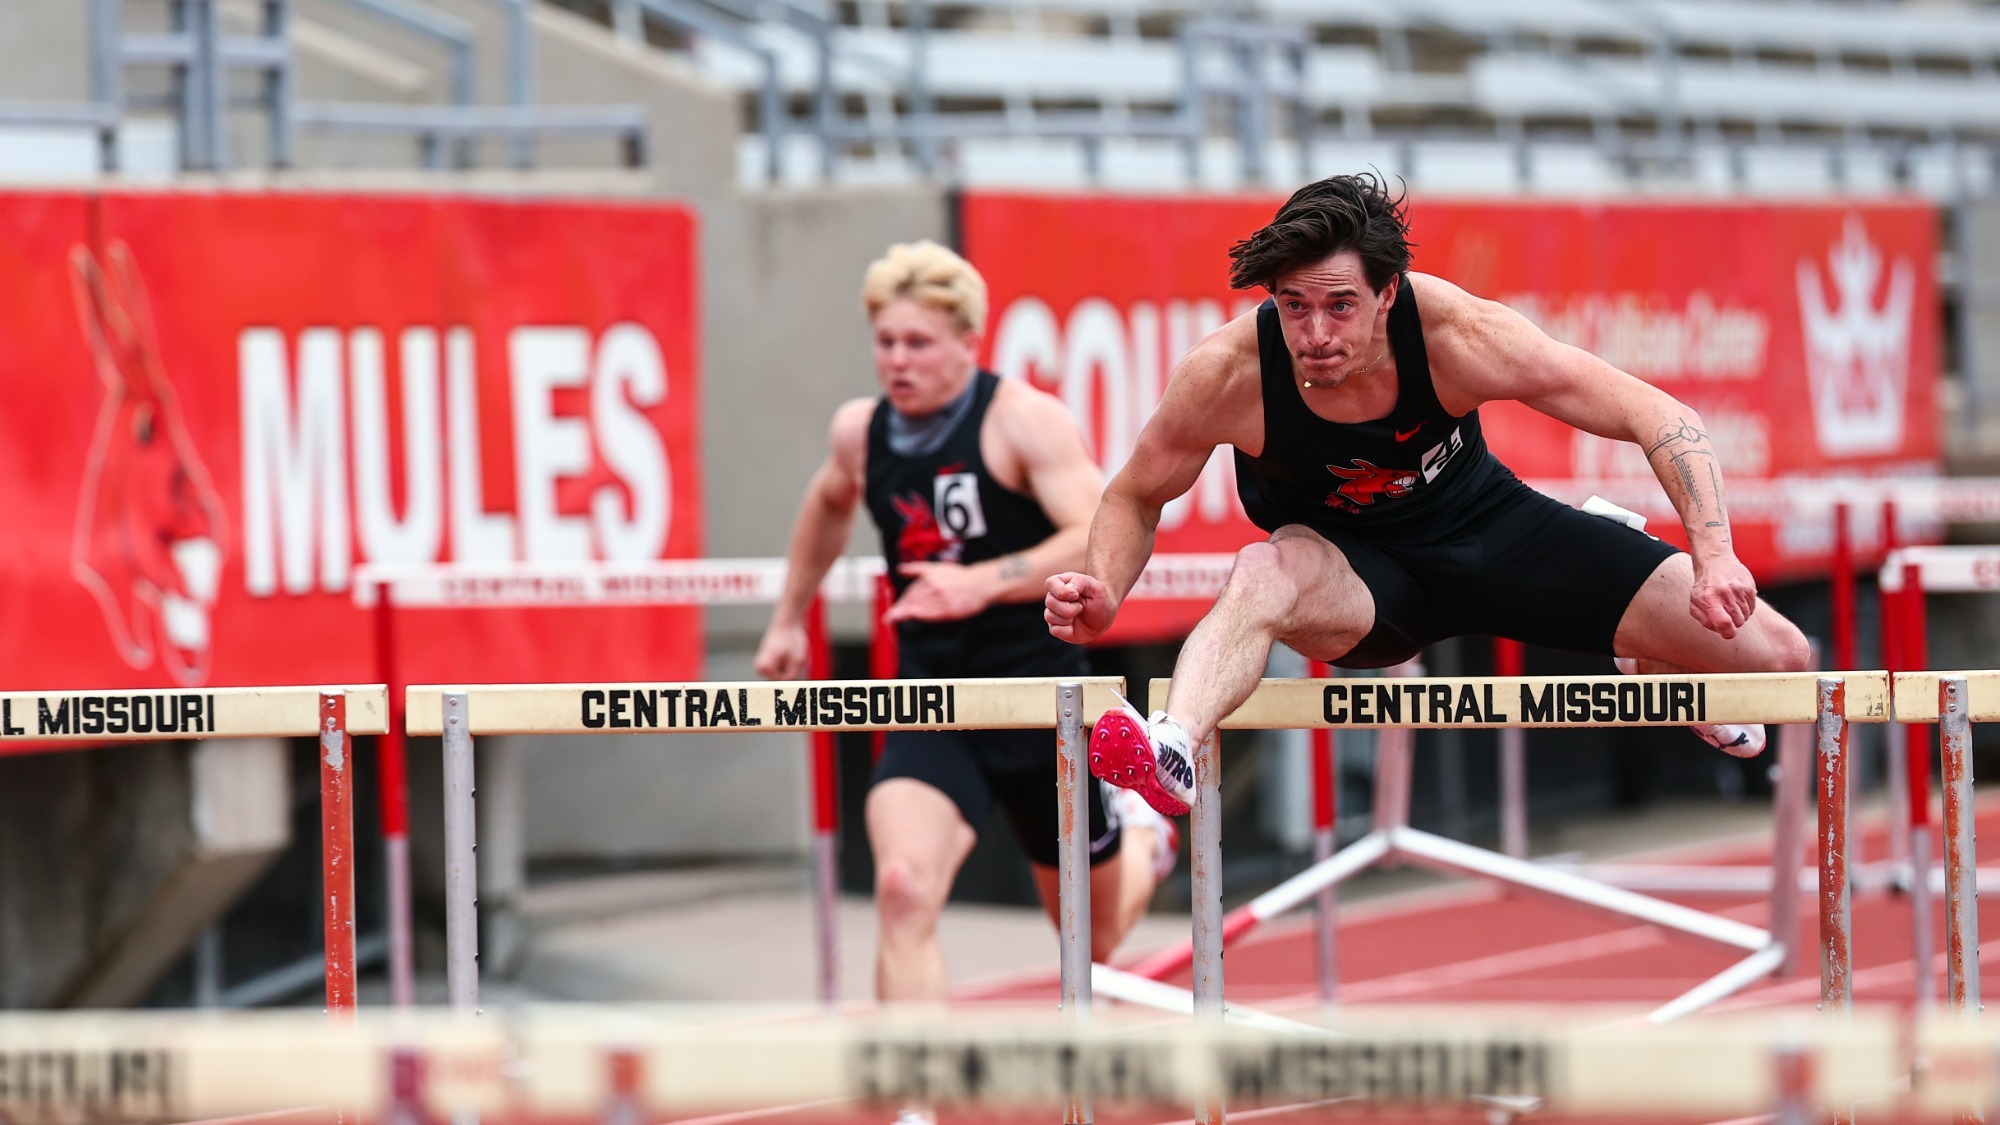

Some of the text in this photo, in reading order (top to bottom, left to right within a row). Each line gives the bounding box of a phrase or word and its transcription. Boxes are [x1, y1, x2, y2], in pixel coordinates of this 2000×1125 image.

[992, 296, 1266, 530] COUN
[238, 321, 671, 597] MULES
[944, 482, 969, 533] 6
[37, 694, 215, 735] MISSOURI
[581, 685, 955, 728] CENTRAL MISSOURI
[1322, 682, 1706, 724] CENTRAL MISSOURI
